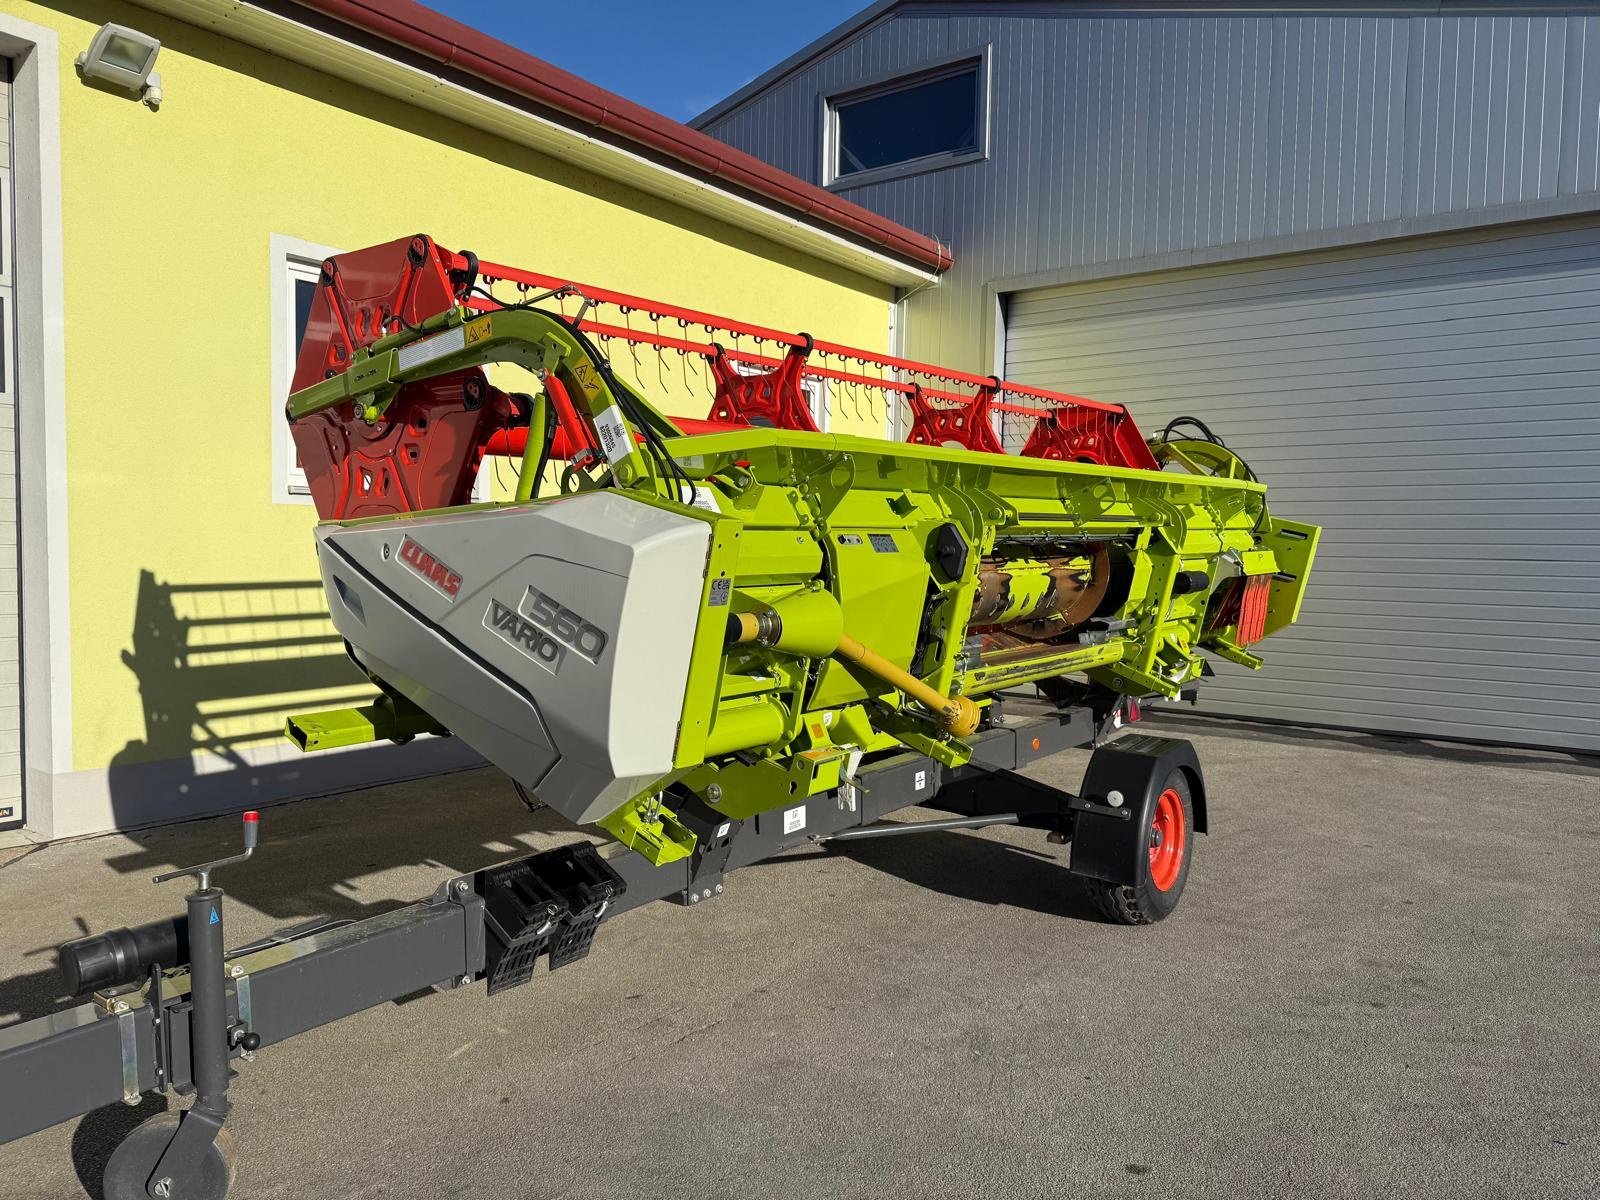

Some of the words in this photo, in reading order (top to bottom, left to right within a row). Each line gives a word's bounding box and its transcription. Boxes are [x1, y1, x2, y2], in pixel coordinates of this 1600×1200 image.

[401, 539, 461, 596] CLAAS
[491, 603, 558, 662] VARIO
[530, 592, 607, 657] 560
